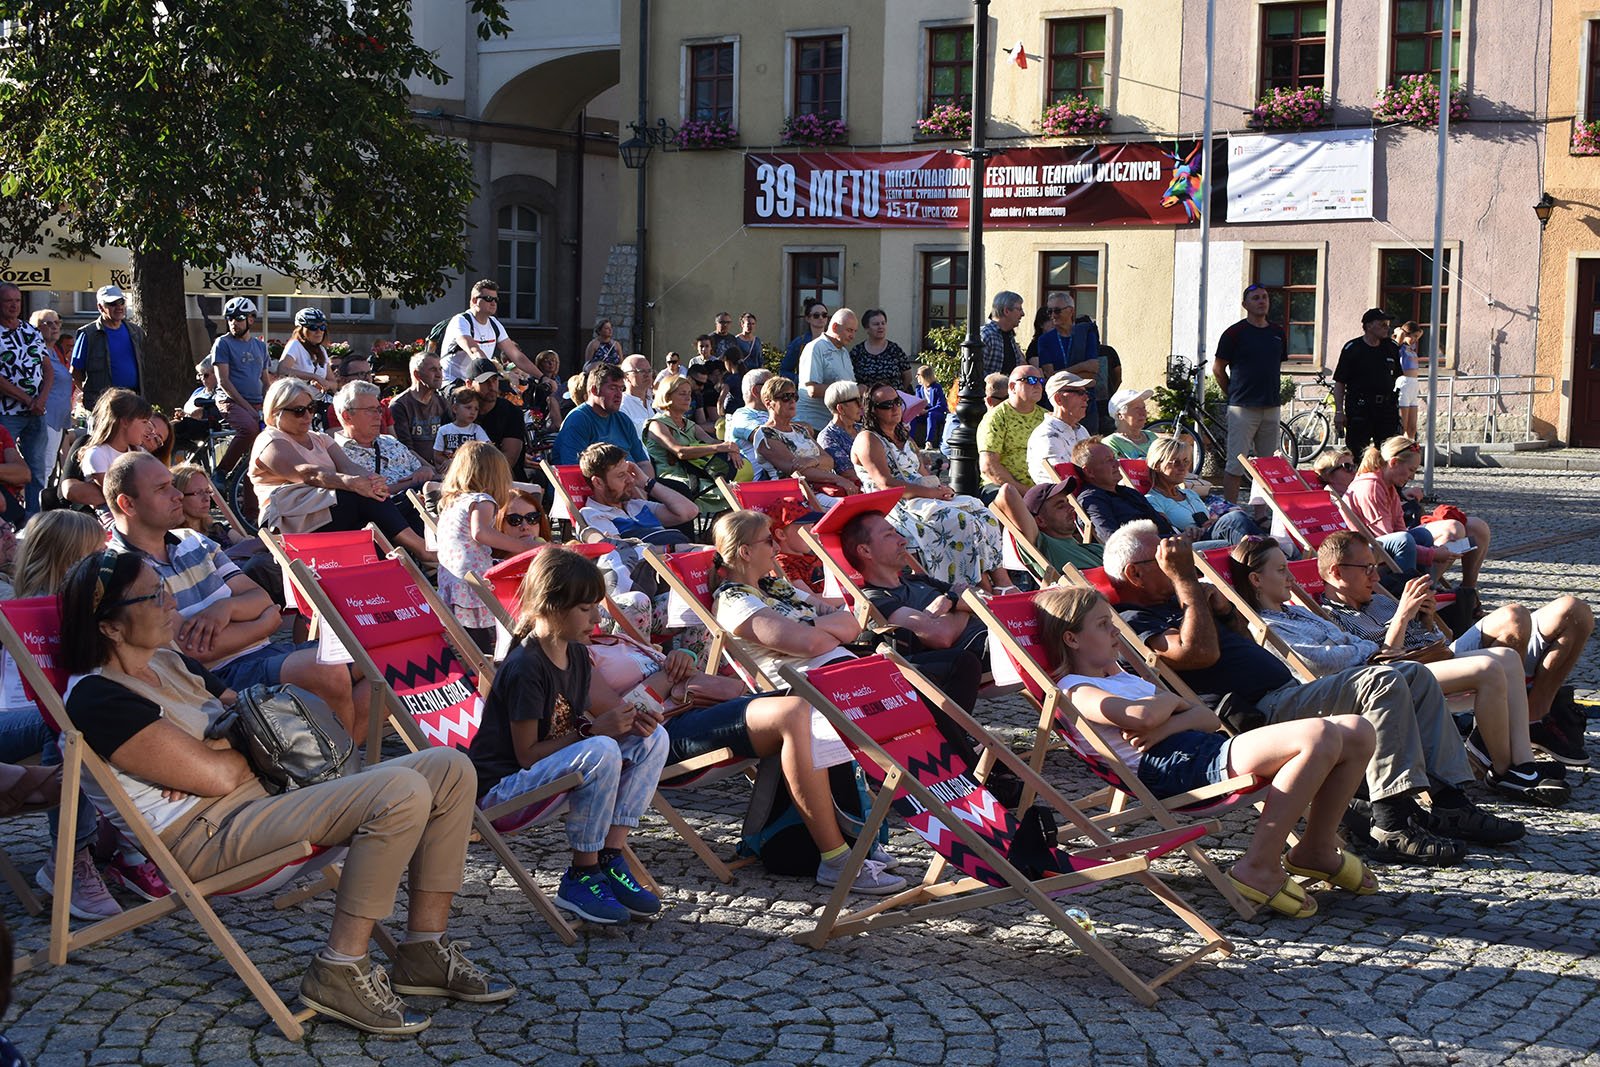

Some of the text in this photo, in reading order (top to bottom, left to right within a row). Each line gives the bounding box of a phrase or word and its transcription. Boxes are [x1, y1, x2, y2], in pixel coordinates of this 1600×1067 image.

[885, 160, 1161, 189] MIĘDZYNARODO FESTIWAL TEATRÓW ULICZNYCH
[809, 169, 880, 217] MFTU
[885, 189, 903, 199] TEATR
[916, 188, 946, 199] CYPRIANA
[982, 187, 1004, 198] RWIDA
[1013, 185, 1043, 198] JELENIEJ
[1044, 184, 1067, 197] GÓRZE
[885, 202, 958, 218] 15-17 LIPCA 2022
[0, 266, 52, 283] ozel
[202, 271, 263, 291] Kozel
[346, 594, 364, 613] Moje
[23, 629, 47, 652] Moje
[402, 688, 450, 715] JELENIA
[832, 687, 852, 706] Moje
[905, 782, 959, 815] JENIA
